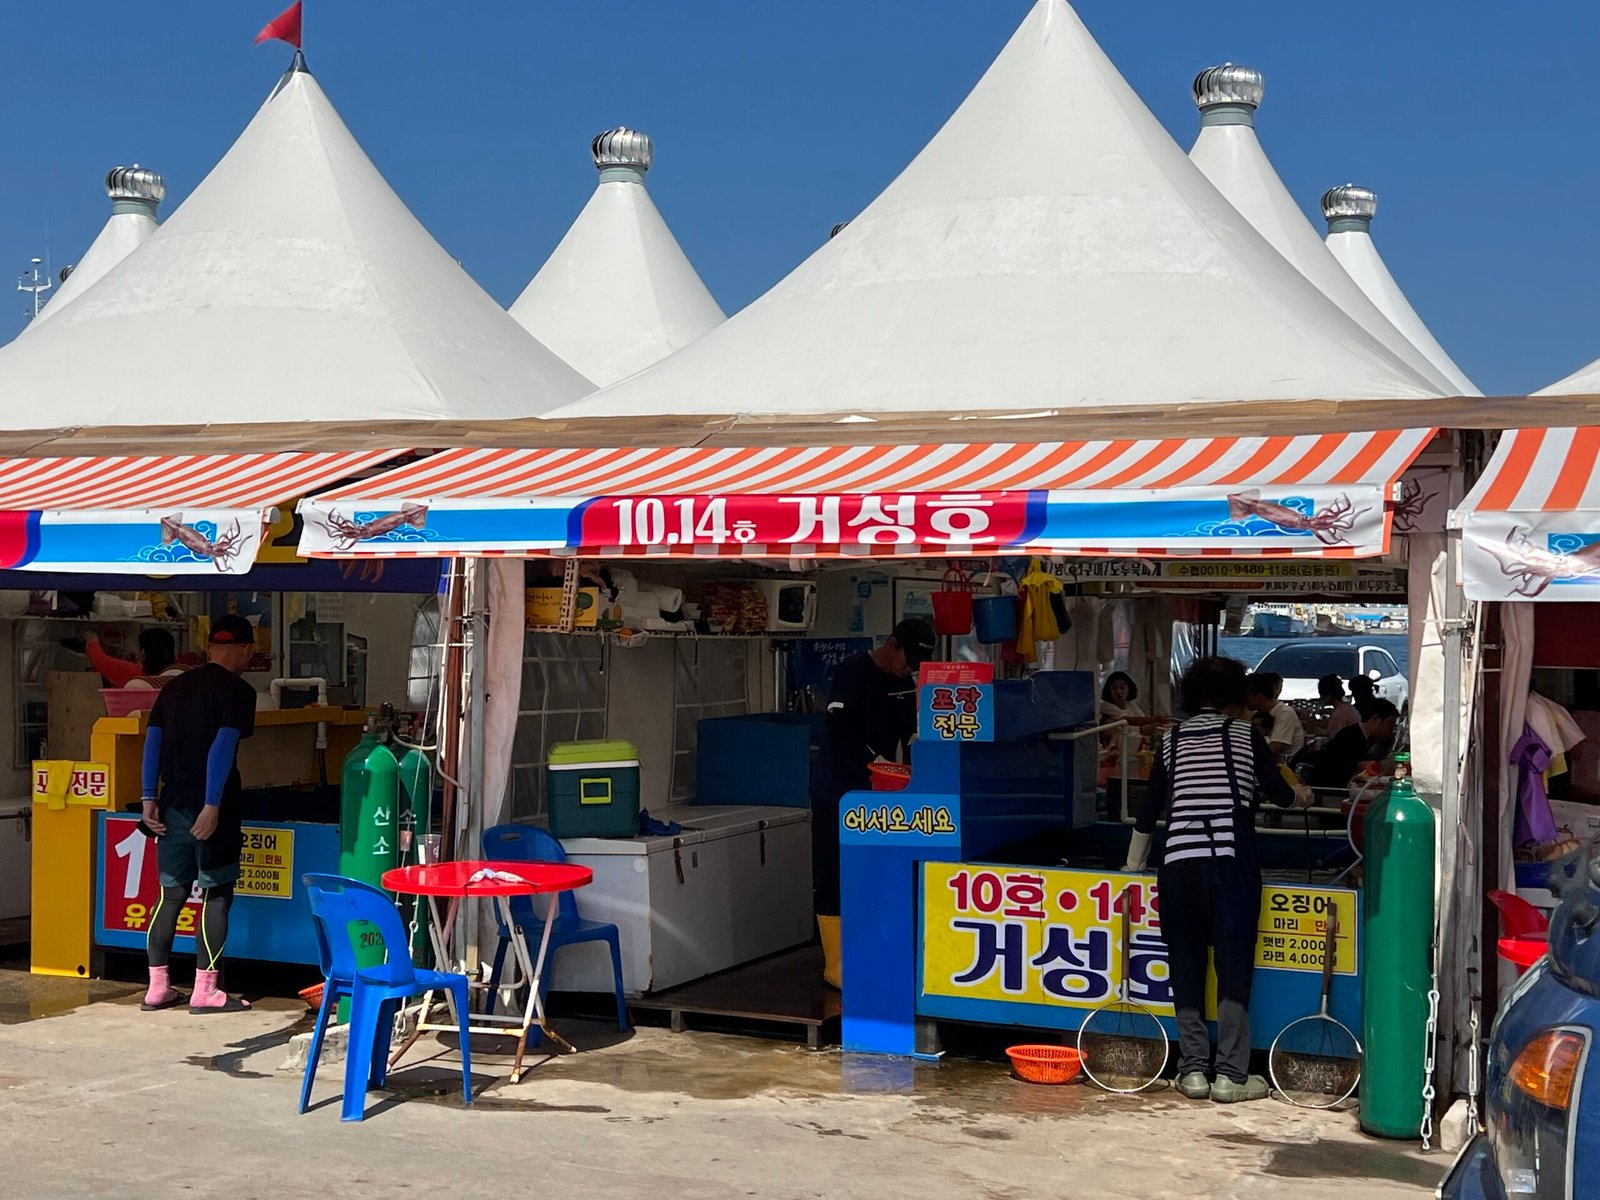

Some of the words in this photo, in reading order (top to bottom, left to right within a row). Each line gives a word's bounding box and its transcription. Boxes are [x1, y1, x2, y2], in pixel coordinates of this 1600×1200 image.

[777, 493, 996, 545] 거성호
[932, 687, 982, 713] 포장
[933, 713, 981, 738] 전문
[36, 770, 106, 797] 포전문
[844, 805, 956, 834] 어서오세요
[248, 869, 280, 880] 2,000원
[247, 881, 279, 892] 4,000원
[1270, 893, 1332, 914] 오징어
[123, 903, 197, 932] 유호
[1273, 917, 1299, 930] 마리
[1262, 936, 1285, 948] 햇반
[1262, 950, 1286, 962] 라면
